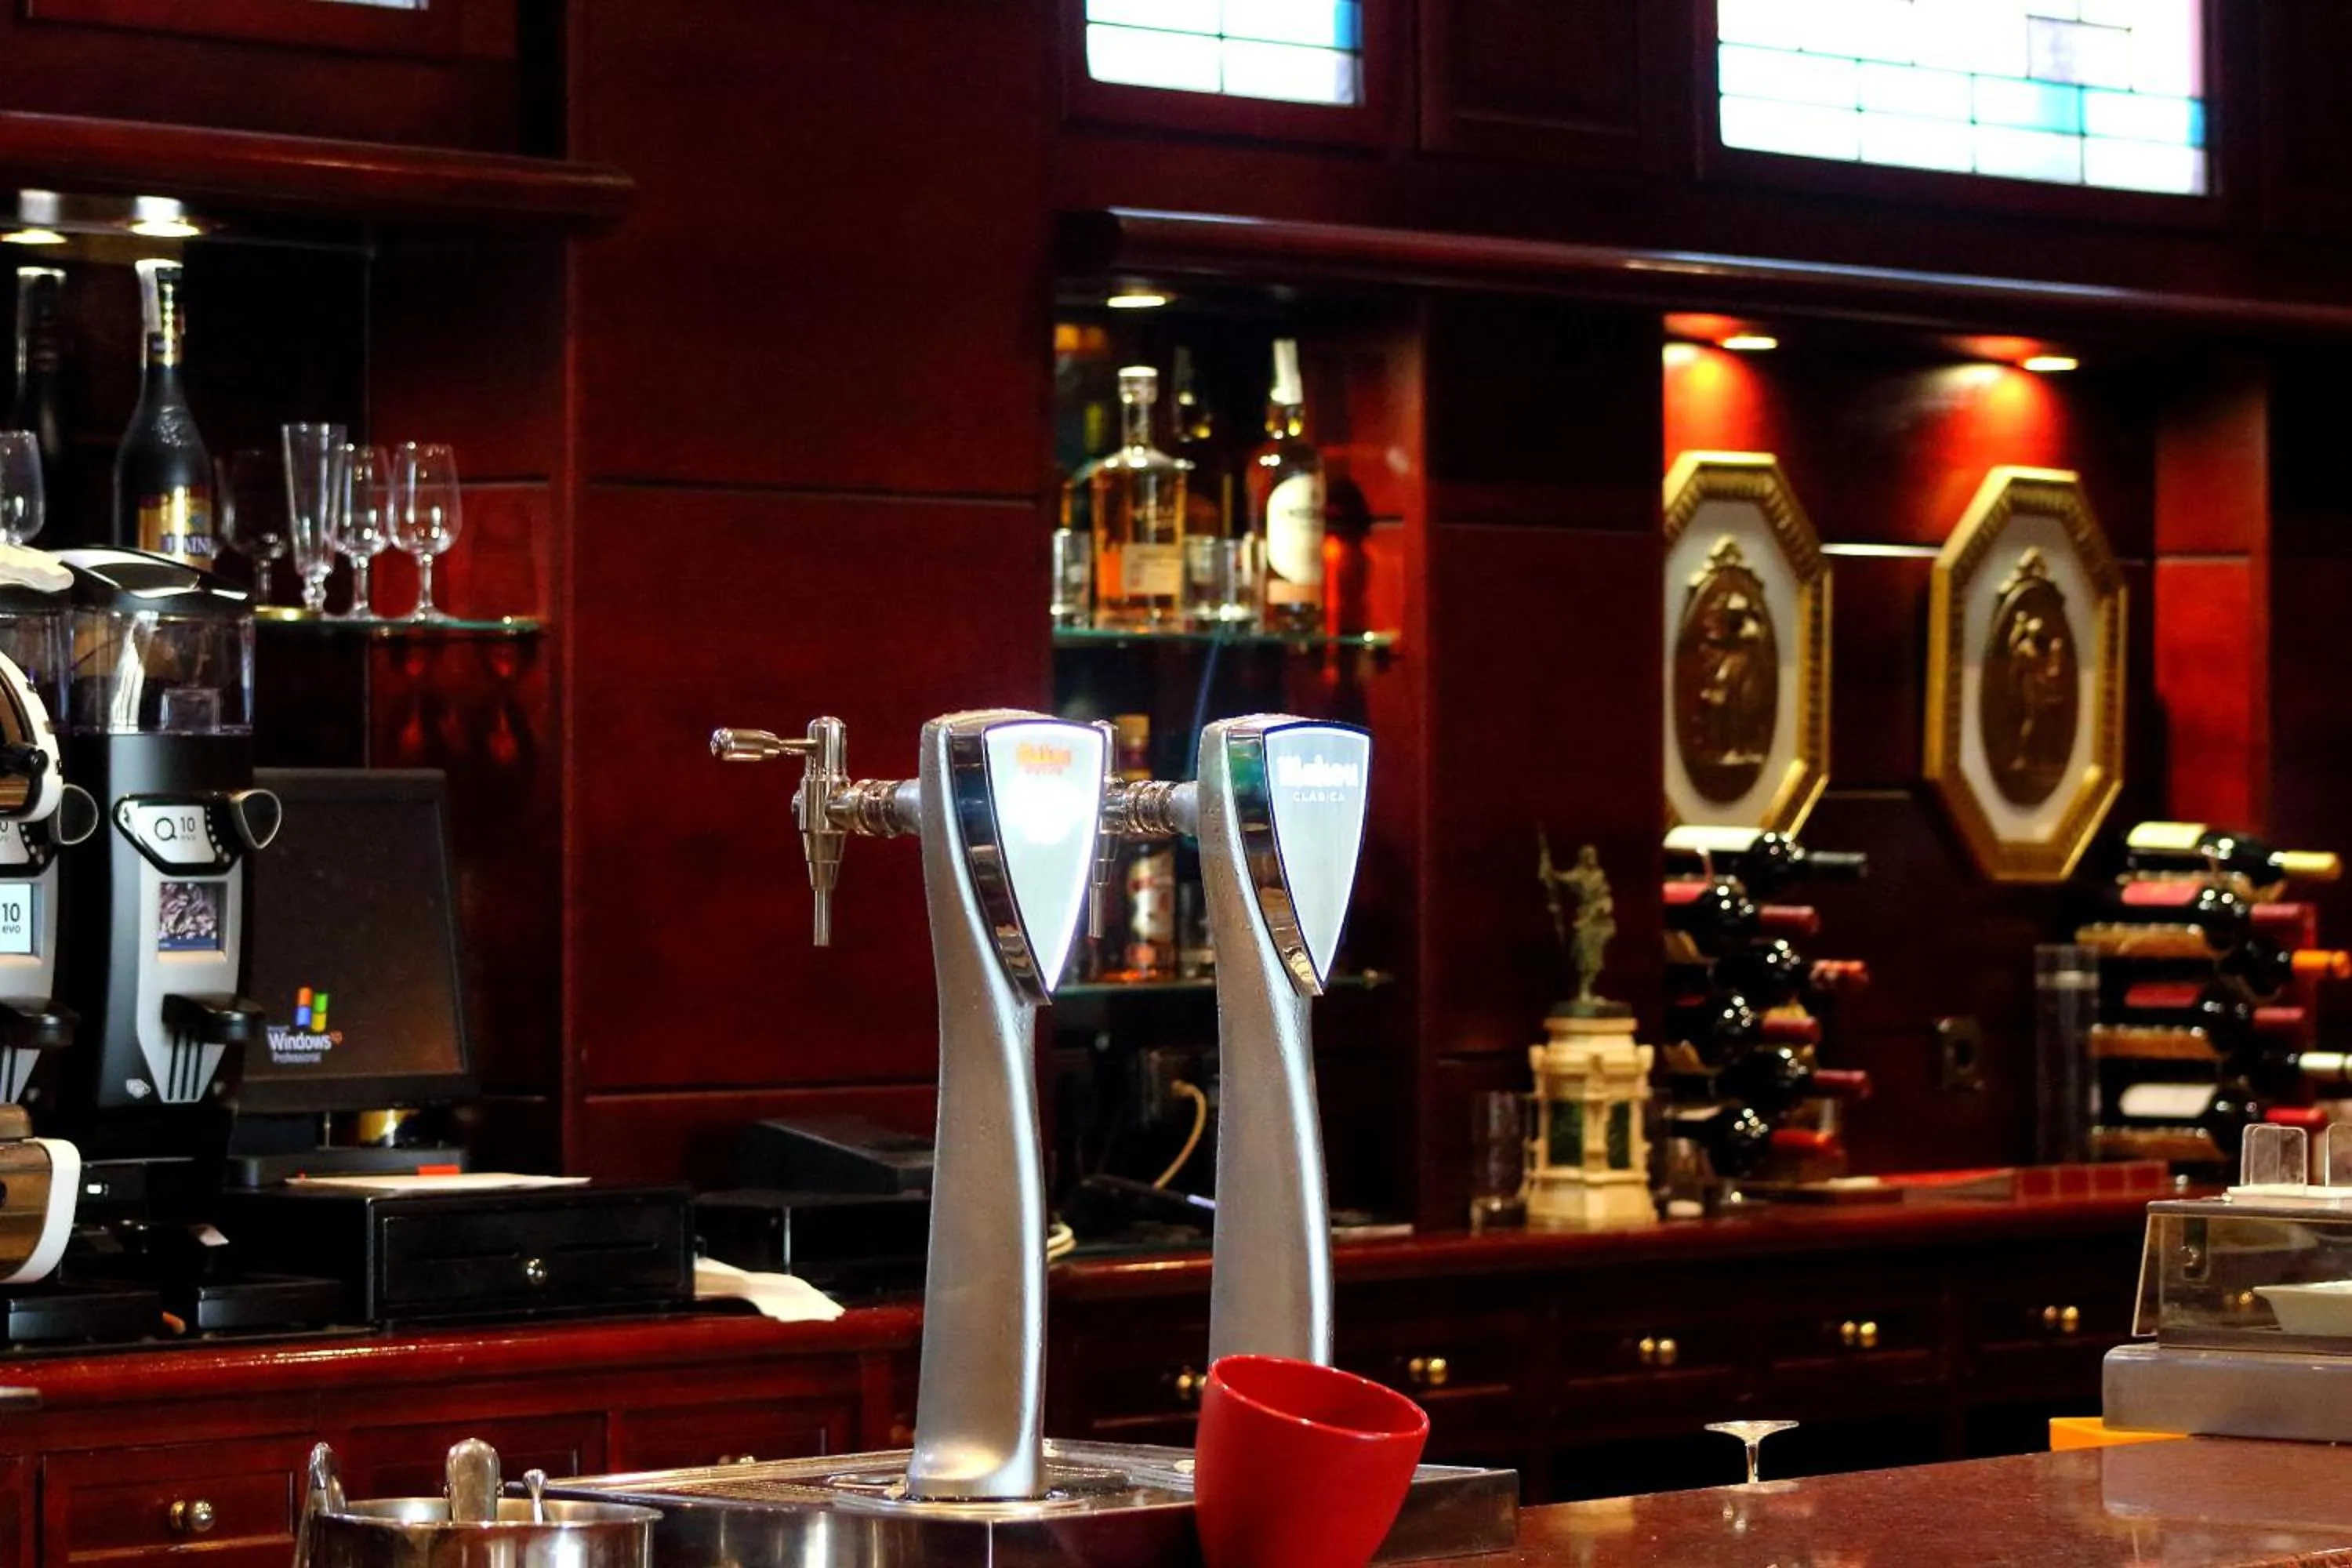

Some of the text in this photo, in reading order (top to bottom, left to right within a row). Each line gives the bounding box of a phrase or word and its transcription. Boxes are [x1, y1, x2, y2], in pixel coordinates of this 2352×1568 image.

[2, 902, 20, 923] 10
[2, 924, 21, 934] evo
[267, 1032, 332, 1051] Windows
